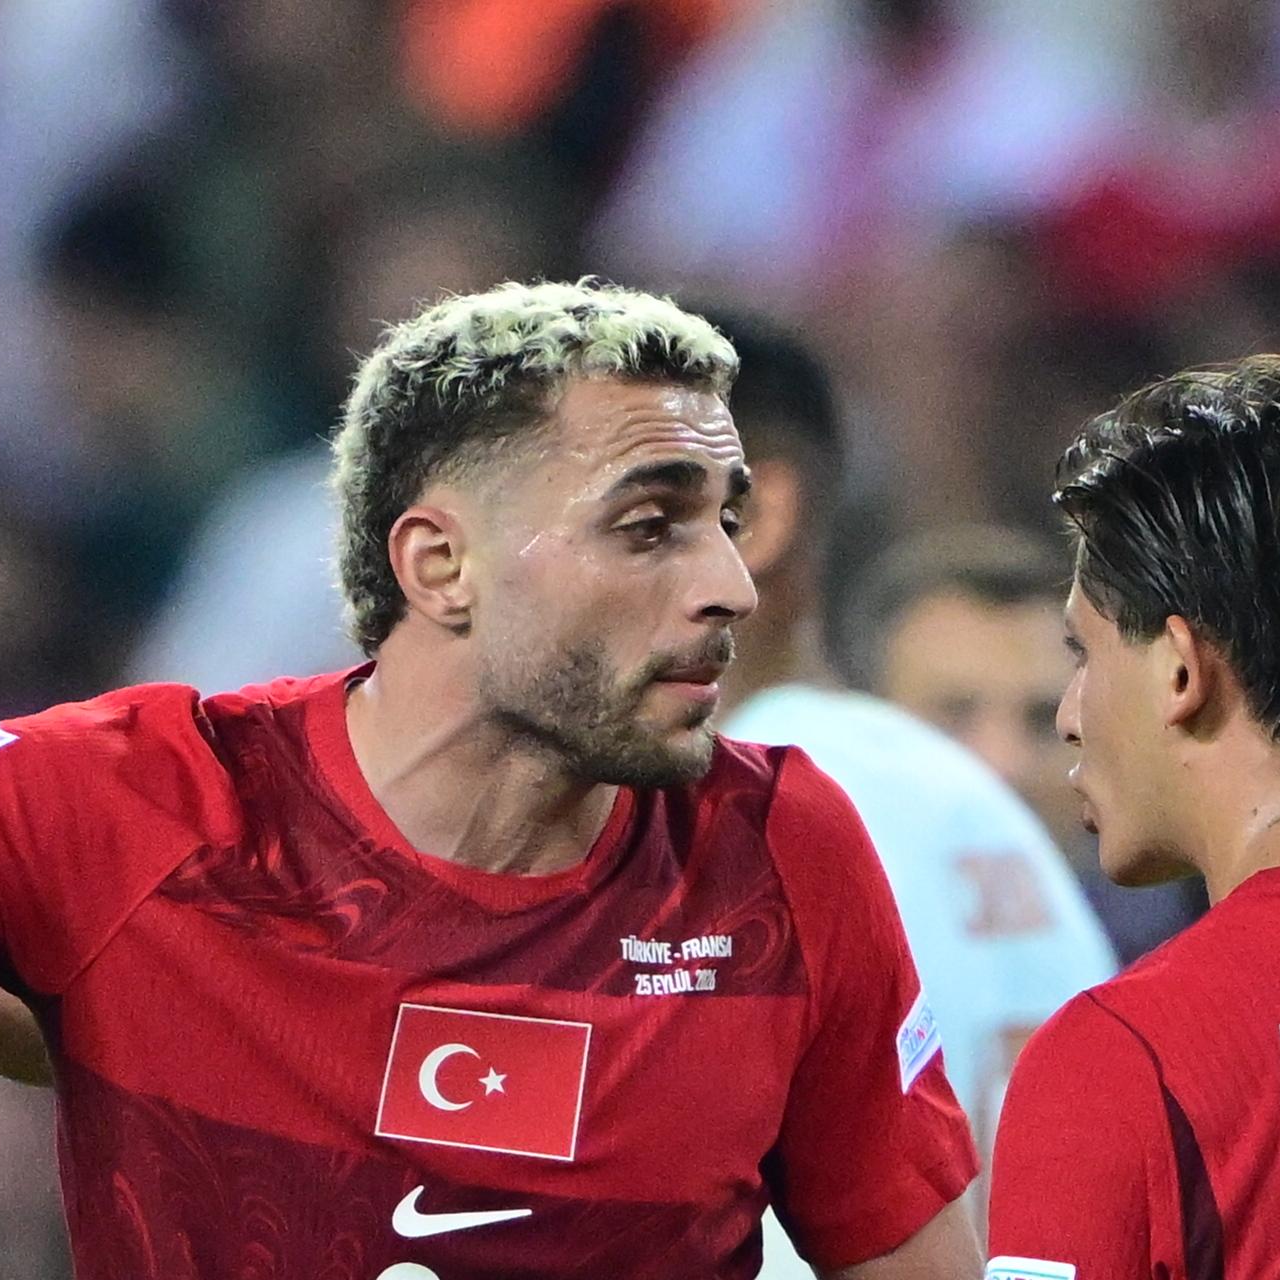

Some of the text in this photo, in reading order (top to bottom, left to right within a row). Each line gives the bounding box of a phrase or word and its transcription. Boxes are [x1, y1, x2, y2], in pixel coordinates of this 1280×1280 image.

[619, 934, 673, 964] TÜRKİYE
[681, 935, 732, 961] FRANSA
[635, 973, 652, 995] 25
[652, 968, 694, 995] EYLÜL
